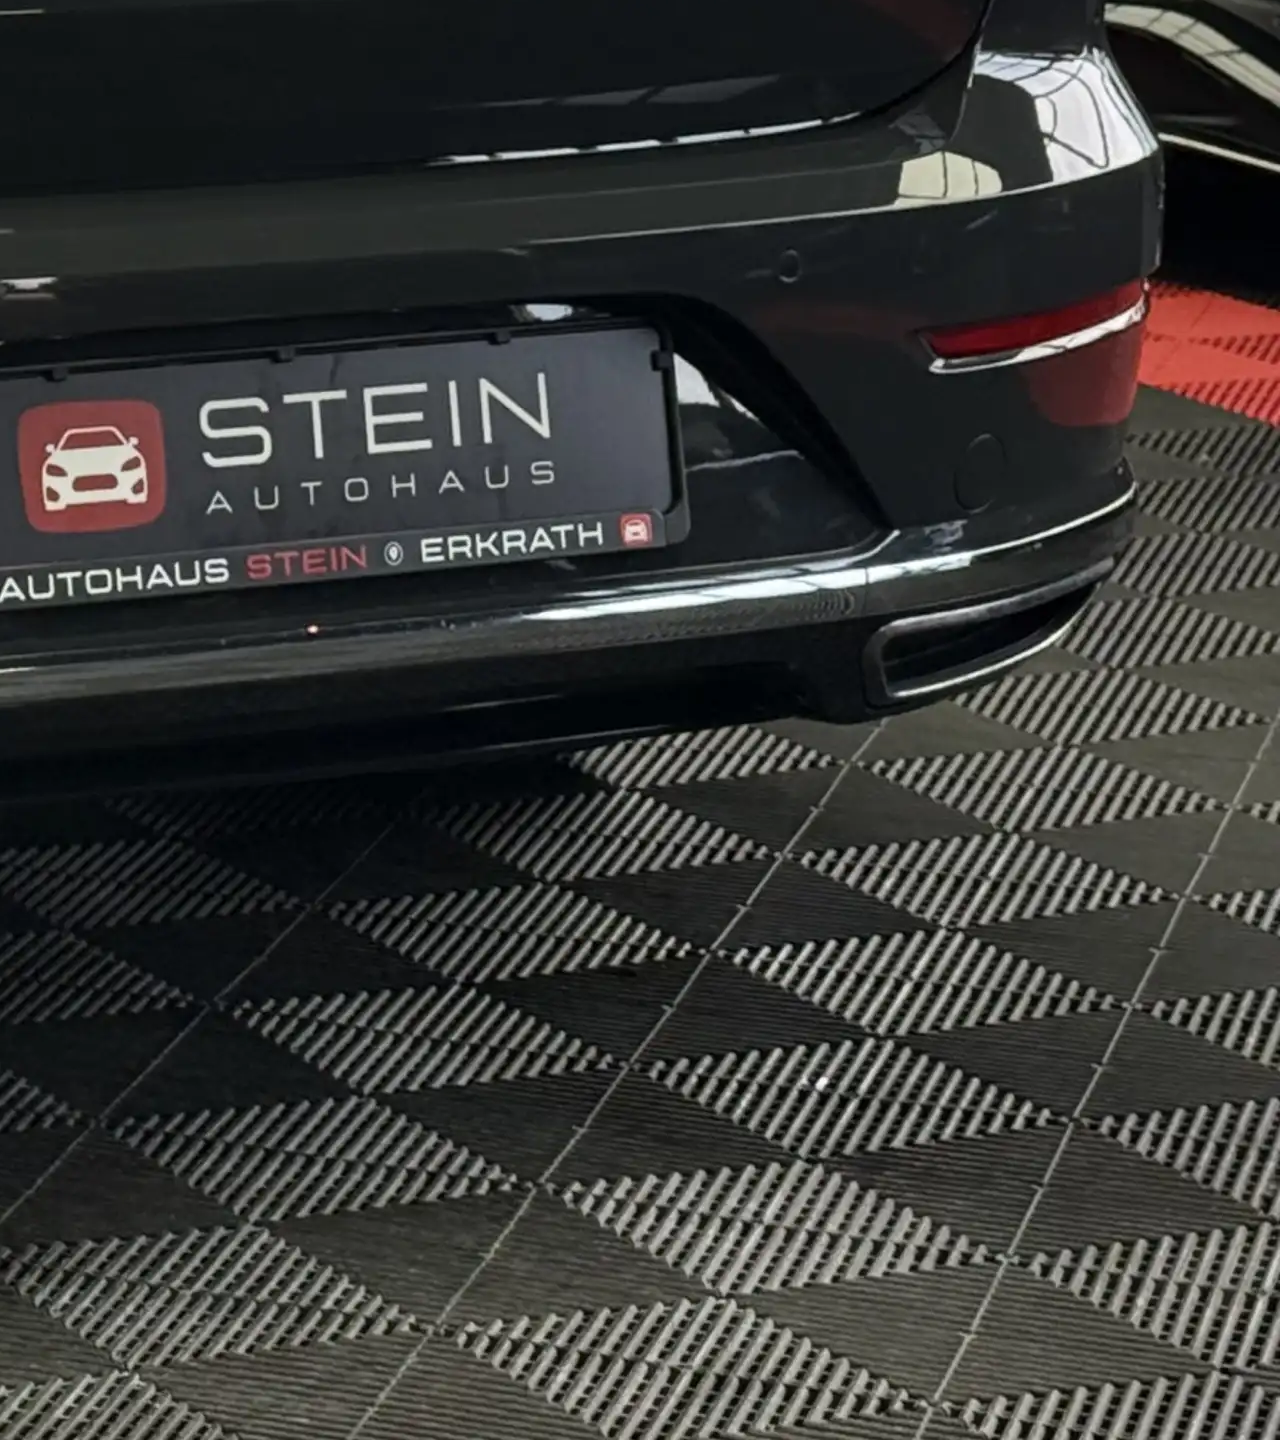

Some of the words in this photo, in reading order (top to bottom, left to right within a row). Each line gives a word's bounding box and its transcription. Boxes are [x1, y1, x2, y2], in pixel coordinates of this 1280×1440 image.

[197, 372, 552, 469] STEIN
[205, 459, 556, 516] AUTOHAUS
[245, 545, 368, 581] STEIN
[419, 522, 604, 565] ERKRATH
